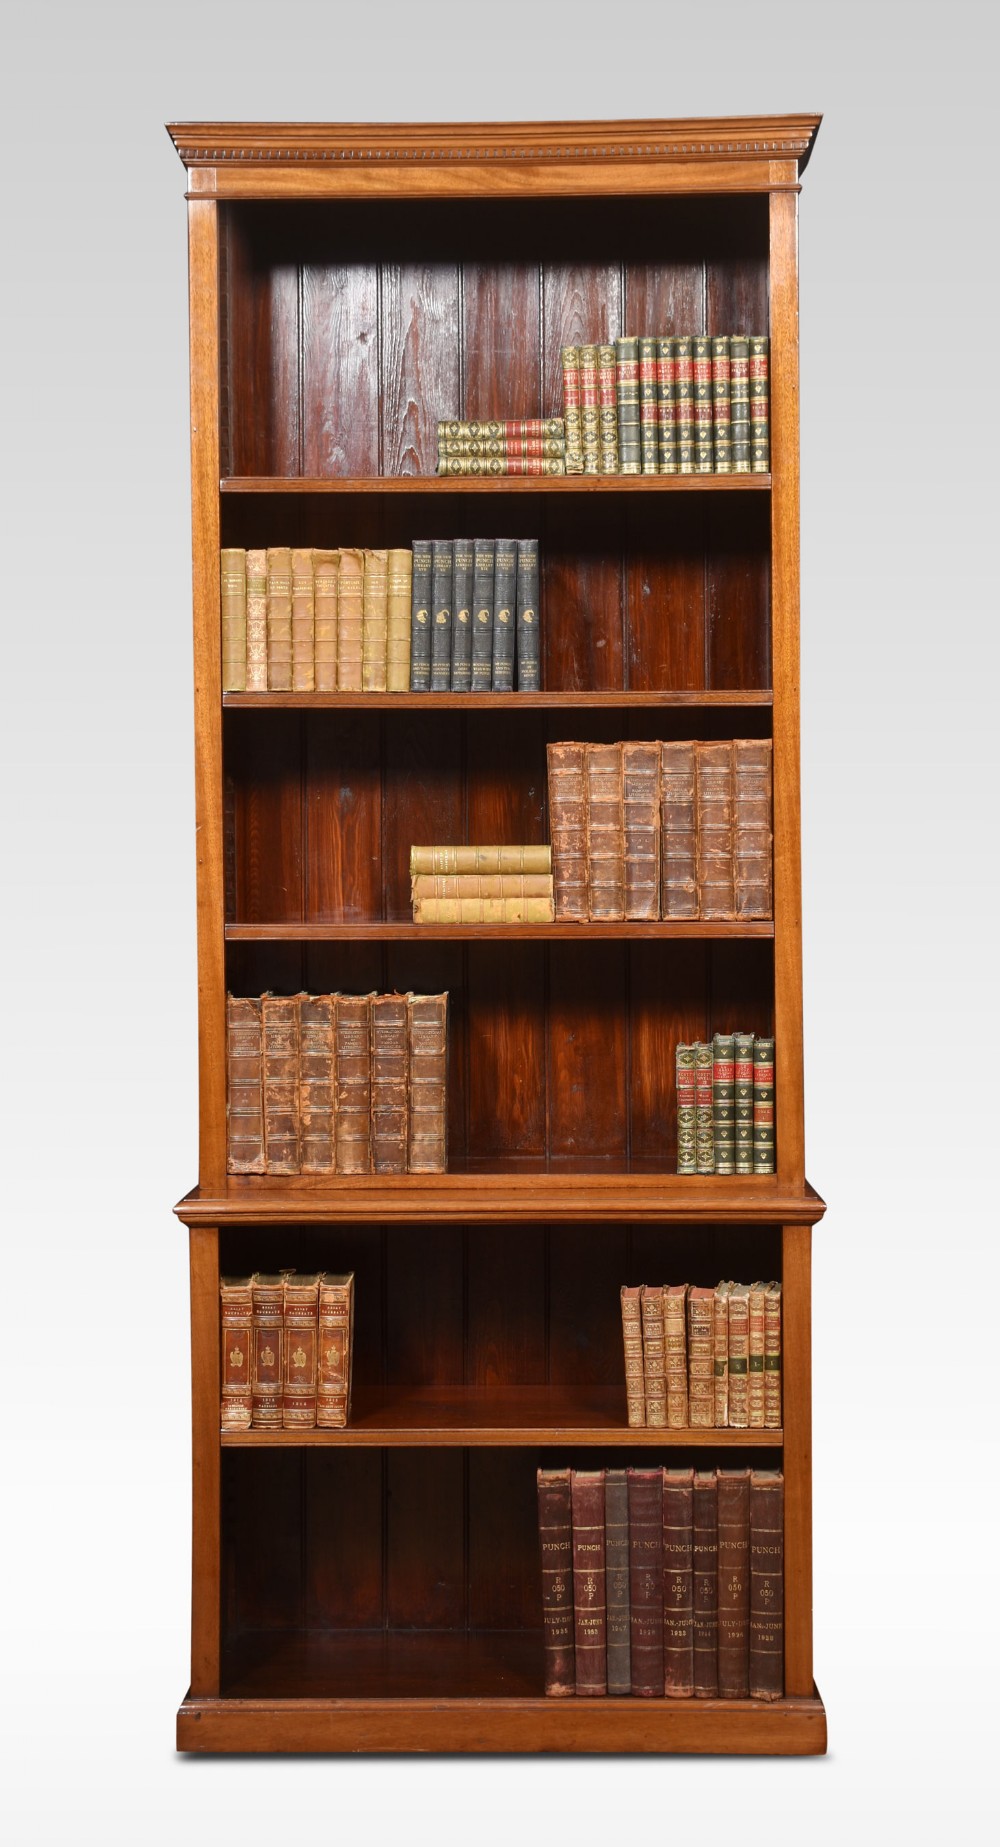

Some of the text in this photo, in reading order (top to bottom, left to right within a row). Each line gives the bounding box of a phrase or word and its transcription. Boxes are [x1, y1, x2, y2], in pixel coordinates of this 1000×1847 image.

[542, 1541, 571, 1551] PUNCH
[577, 1544, 601, 1552] PUNCH
[632, 1540, 661, 1549] PUNCH
[664, 1543, 693, 1553] PUNCH
[694, 1544, 718, 1552] PUNCH
[719, 1541, 748, 1549] PUNCH
[751, 1546, 781, 1554] PUNCH
[555, 1576, 562, 1584] R
[587, 1577, 594, 1585] R
[676, 1576, 682, 1584] R
[732, 1575, 739, 1583] R
[583, 1584, 597, 1592] 050
[728, 1583, 742, 1592] 050
[764, 1580, 770, 1588] R
[671, 1584, 687, 1593] 050
[588, 1592, 595, 1601] P
[676, 1593, 683, 1601] P
[732, 1592, 739, 1600] P
[759, 1589, 774, 1597] 050
[556, 1593, 562, 1602] P
